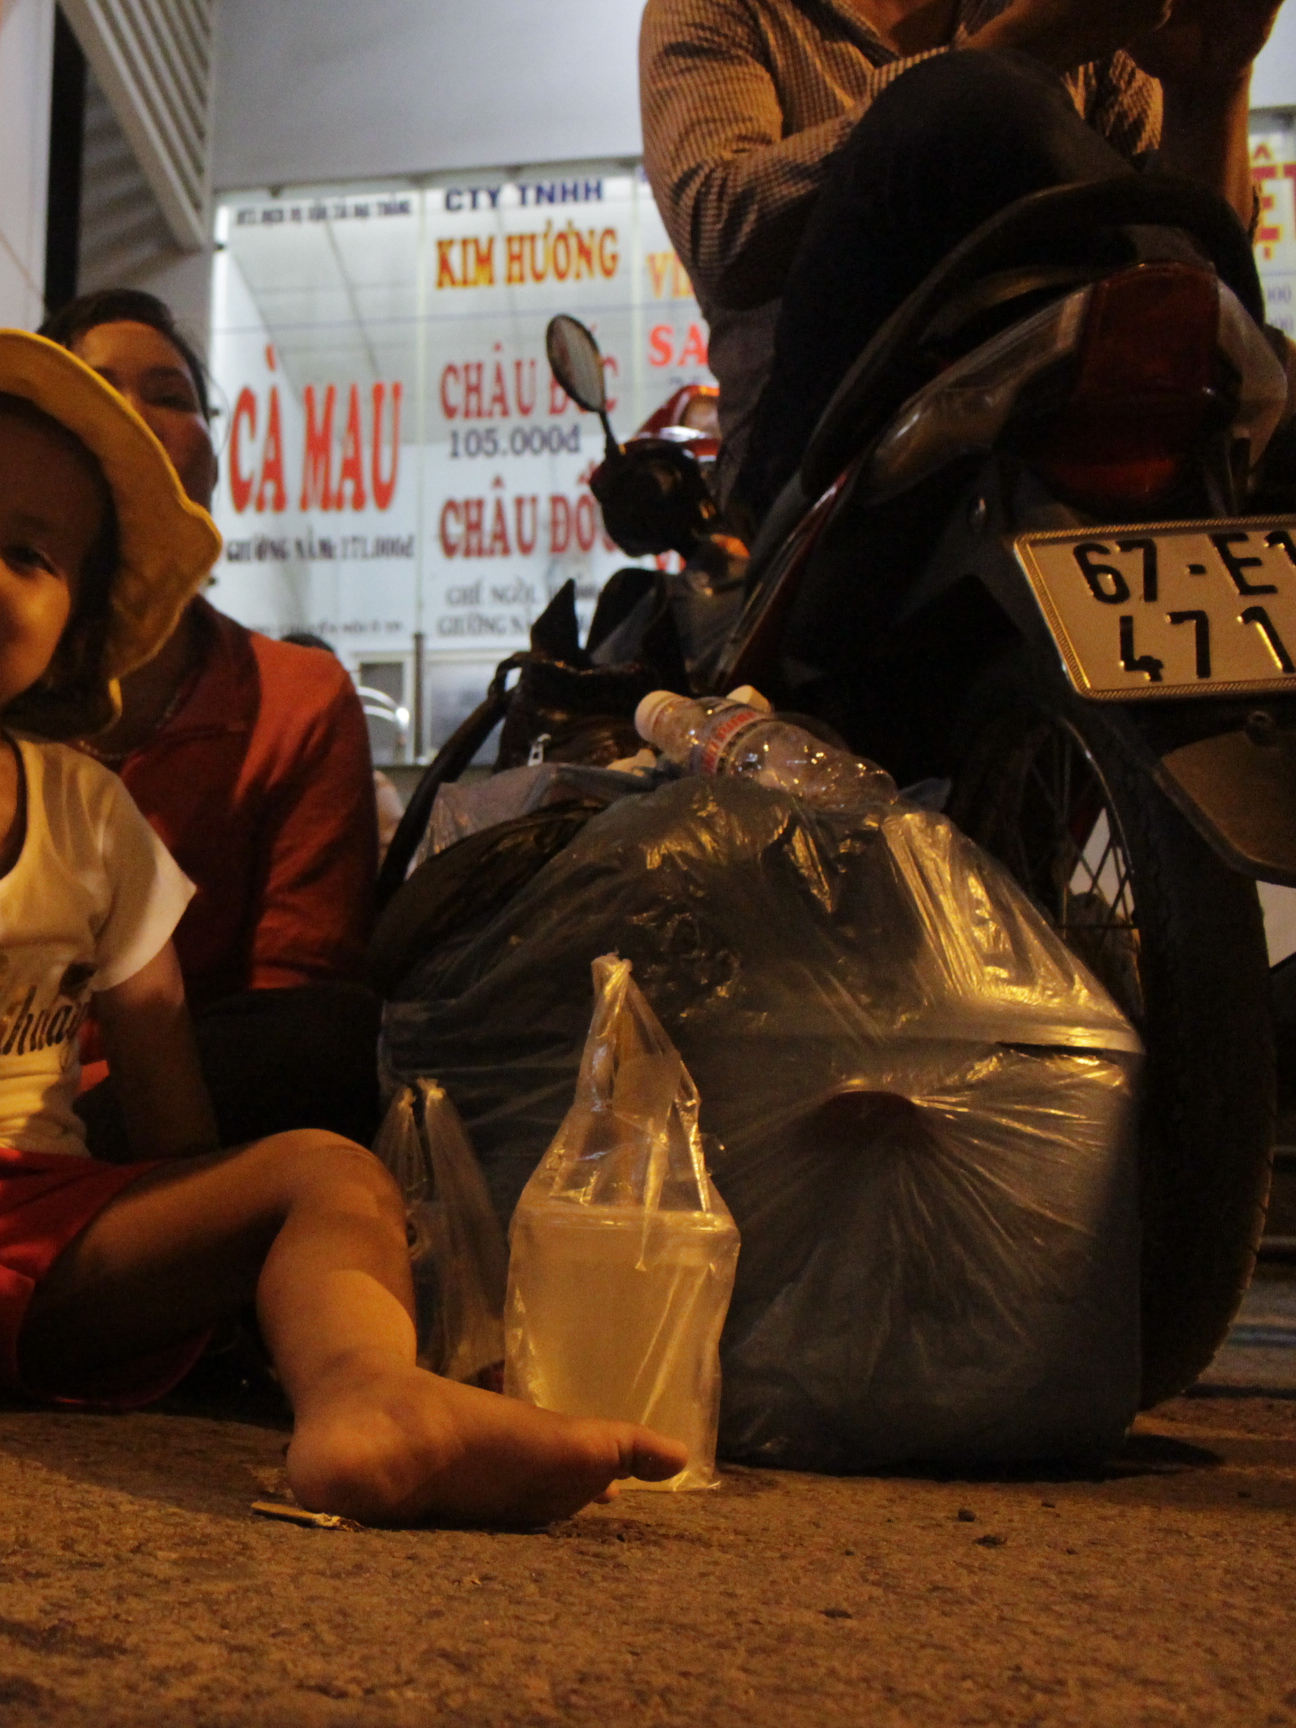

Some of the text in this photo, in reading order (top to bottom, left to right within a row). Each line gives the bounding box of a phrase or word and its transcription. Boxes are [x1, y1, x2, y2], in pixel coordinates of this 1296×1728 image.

[445, 179, 602, 211] CTY TNHH
[436, 236, 495, 289] KIM
[299, 381, 403, 512] MAU
[439, 474, 538, 558] CHÂU
